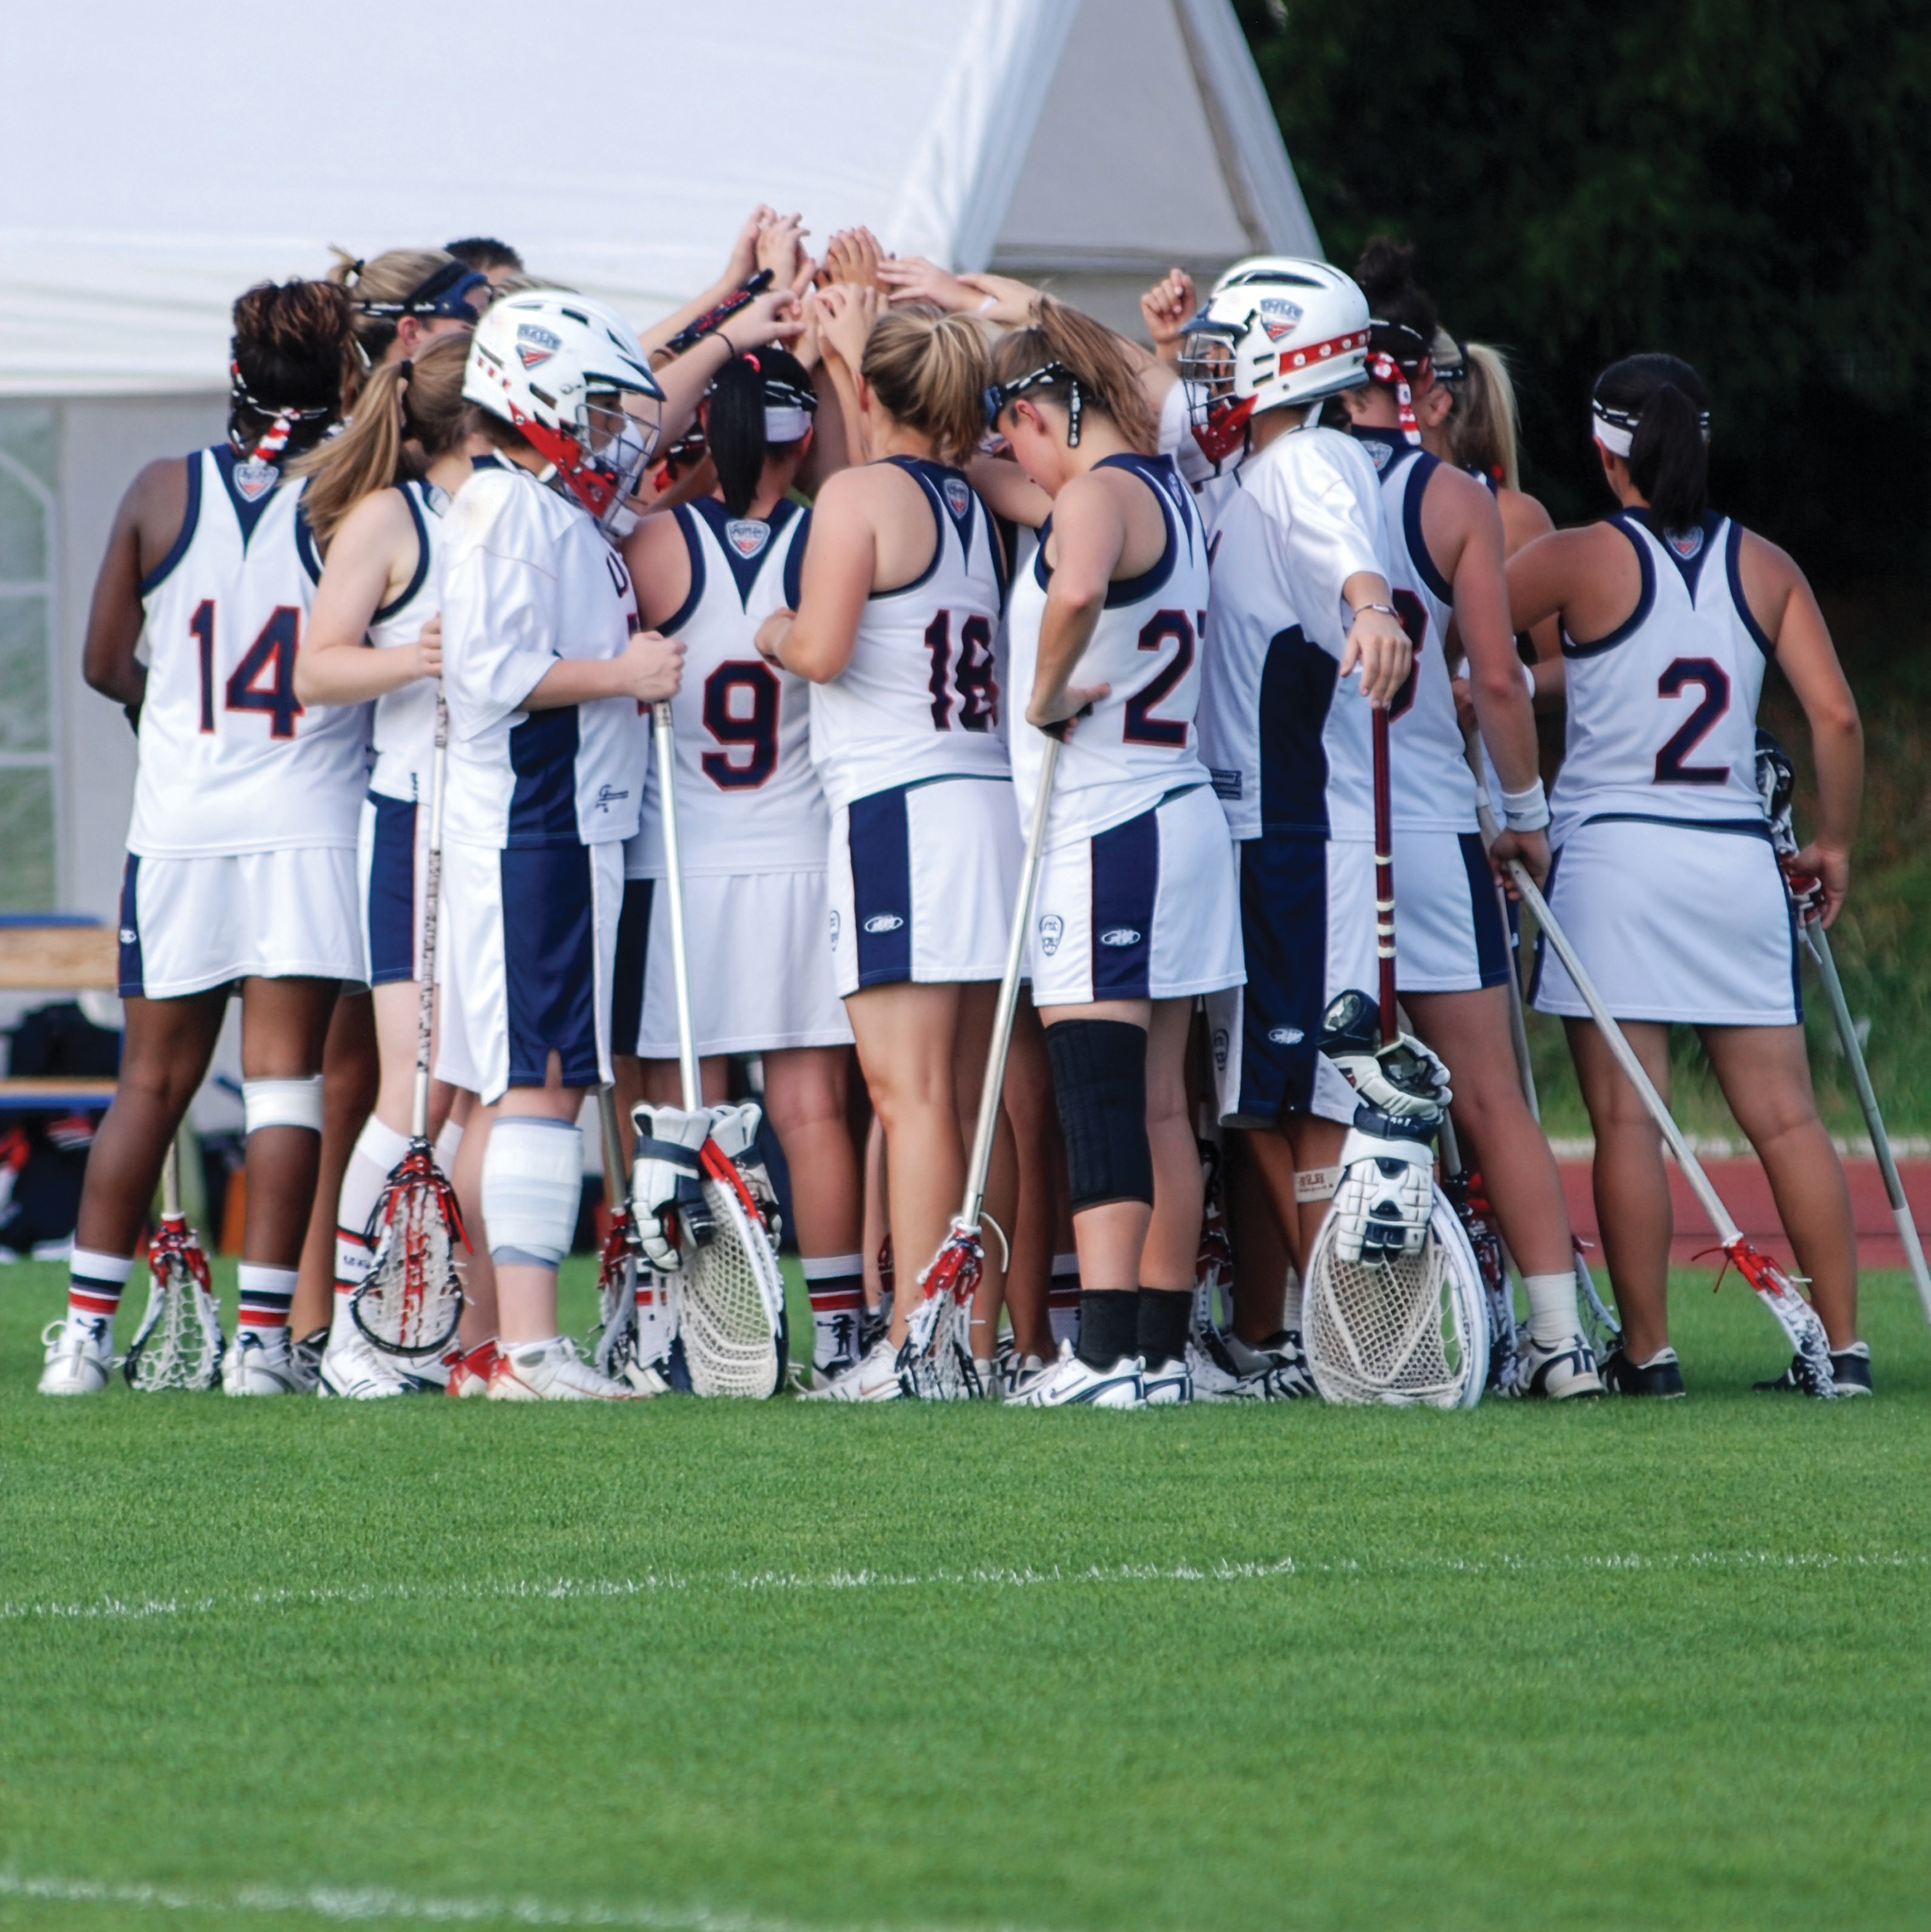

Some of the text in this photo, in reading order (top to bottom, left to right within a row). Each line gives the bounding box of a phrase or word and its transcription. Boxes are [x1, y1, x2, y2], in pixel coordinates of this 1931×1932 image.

[189, 599, 304, 739] 14
[703, 660, 779, 791] 9
[1122, 609, 1206, 749] 2
[1654, 657, 1731, 784] 2
